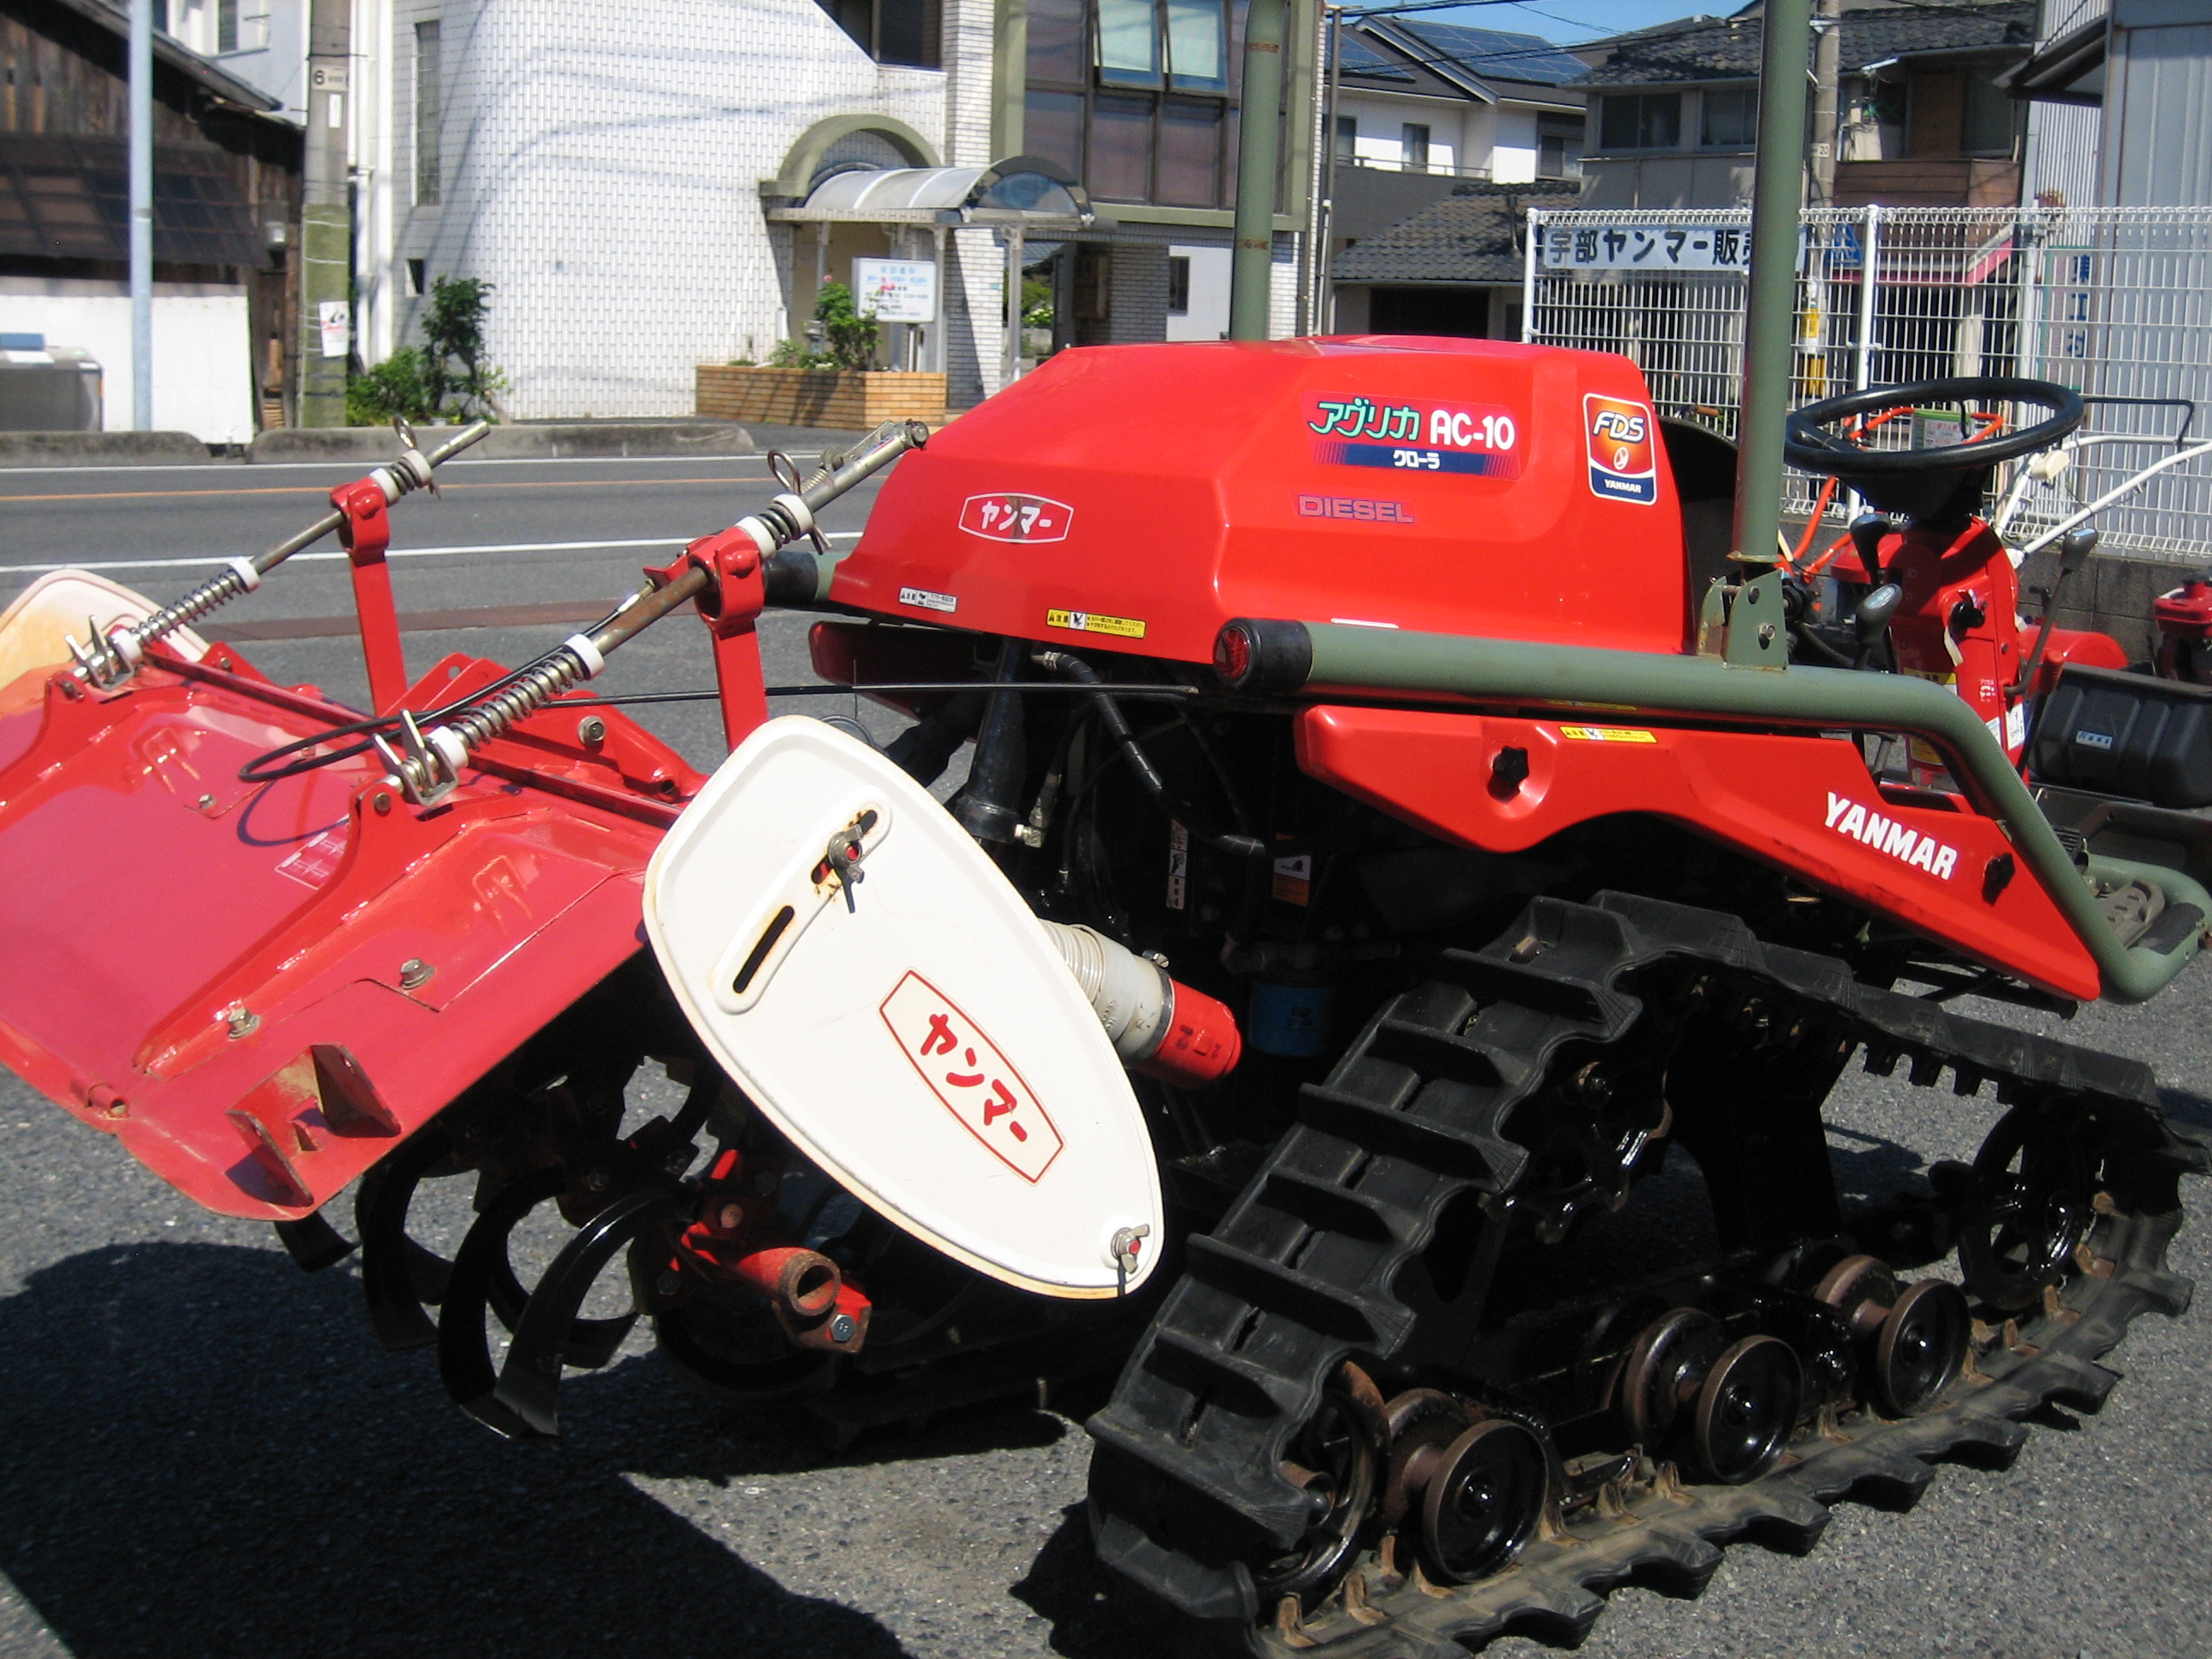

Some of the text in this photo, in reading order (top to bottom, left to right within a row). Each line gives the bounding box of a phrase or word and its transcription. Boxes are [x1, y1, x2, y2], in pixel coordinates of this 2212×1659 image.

[1307, 397, 1516, 451] アグリカ AC-10
[1592, 410, 1645, 443] FDS
[1392, 448, 1441, 469] クローラ
[1604, 478, 1643, 493] YANMAR
[981, 500, 1053, 534] ヤンマー
[1298, 494, 1415, 524] DIESEL
[1824, 790, 1959, 881] YANMAR
[919, 1013, 1028, 1143] ヤンマー
